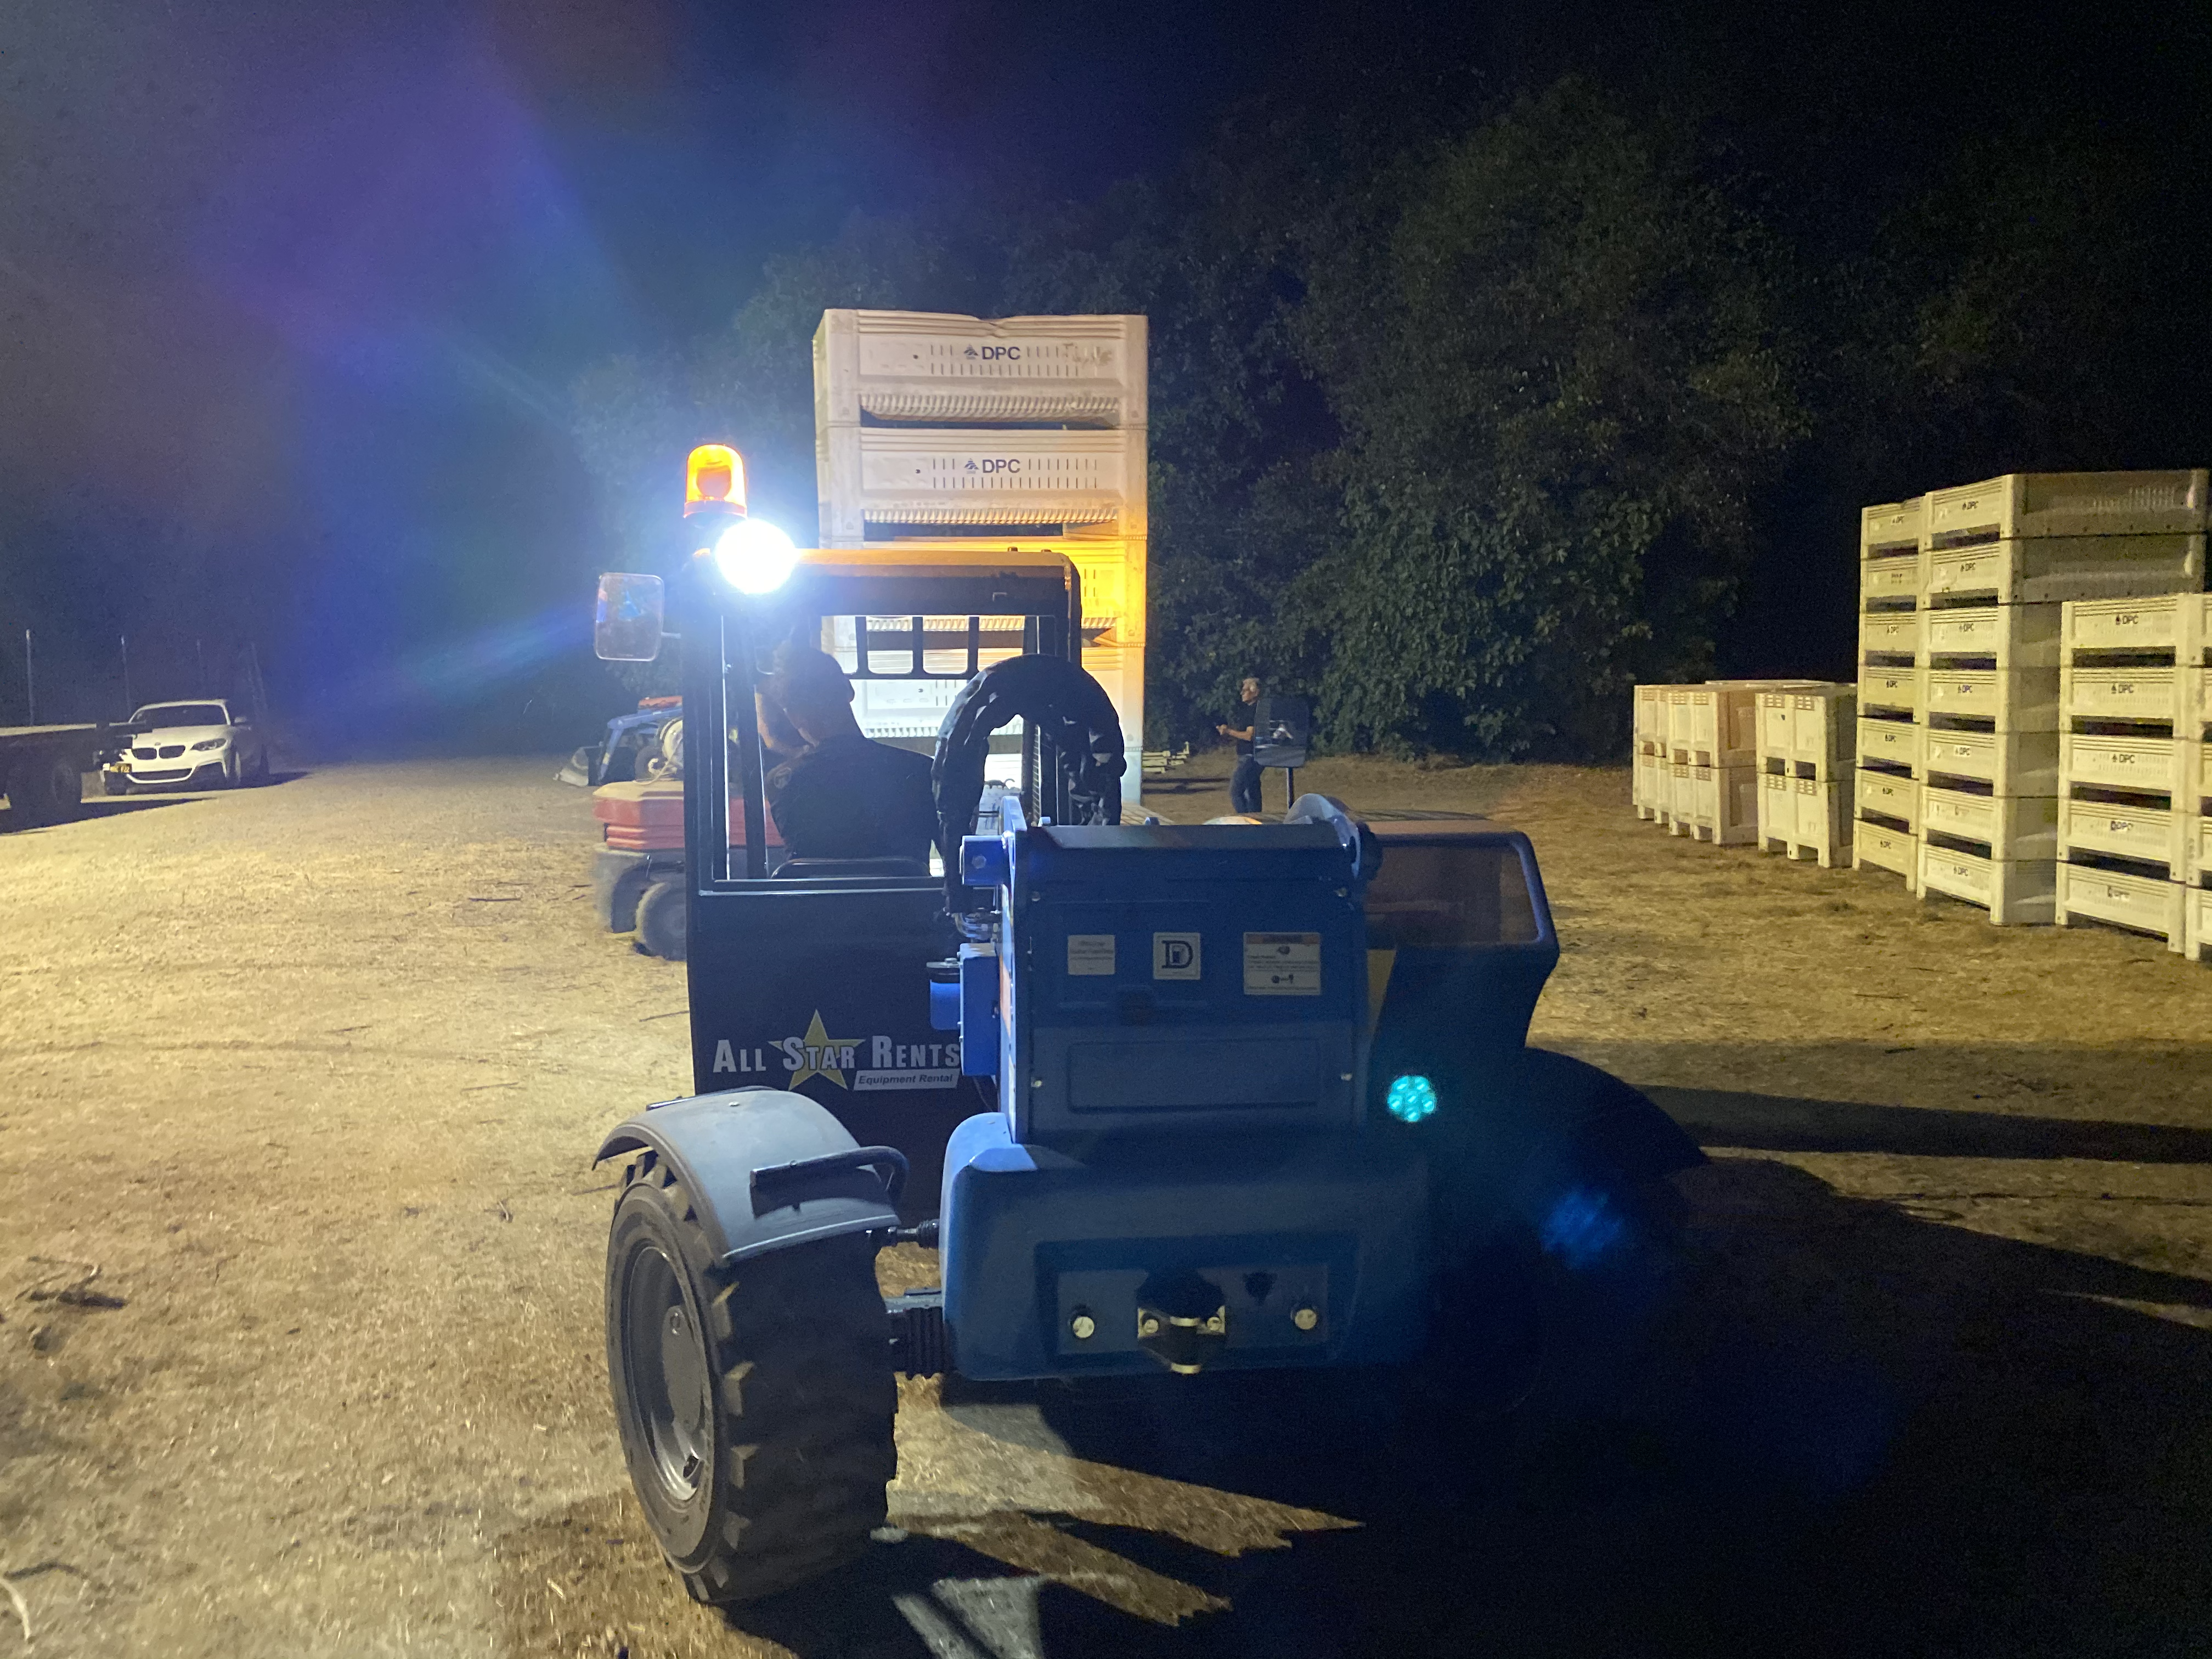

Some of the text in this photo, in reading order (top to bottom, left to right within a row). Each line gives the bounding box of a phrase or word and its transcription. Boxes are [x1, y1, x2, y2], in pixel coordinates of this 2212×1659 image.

[981, 346, 1020, 360] DPC
[982, 459, 1020, 473] DPC
[1967, 501, 1979, 509] DPC
[1965, 562, 1976, 572] DPC
[2122, 615, 2138, 624] DPC
[1963, 623, 1974, 631] DPC
[1962, 685, 1973, 693] DPC
[2118, 684, 2134, 693] DPC
[1959, 747, 1971, 756] DPC
[2119, 754, 2135, 764] DPC
[1883, 841, 1892, 849] DPC
[1957, 867, 1968, 877] DPC
[1161, 940, 1193, 969] D
[858, 1074, 953, 1085] Equipment Rental
